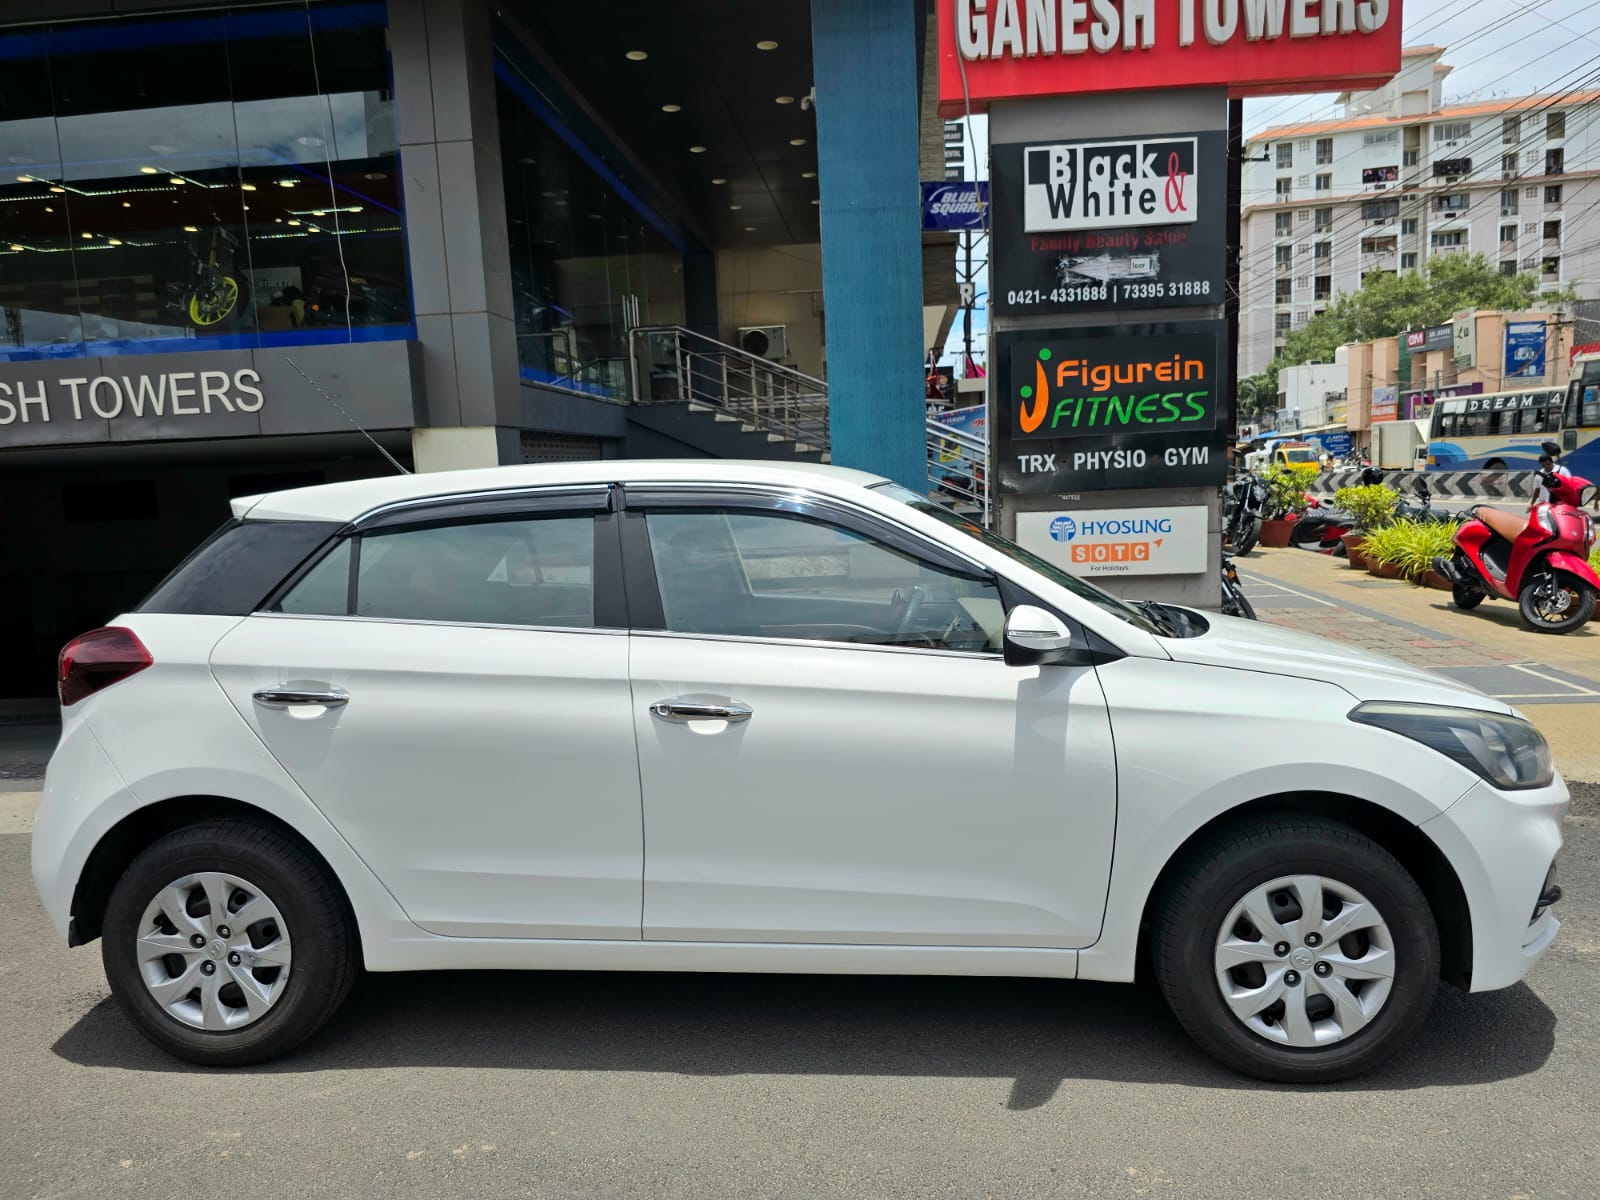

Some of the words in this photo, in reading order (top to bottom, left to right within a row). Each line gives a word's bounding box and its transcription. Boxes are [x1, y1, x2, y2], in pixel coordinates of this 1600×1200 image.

[957, 0, 1155, 60] GANESH
[1179, 0, 1389, 47] TOWERS
[1050, 145, 1158, 185] Black
[941, 191, 977, 203] BLUE
[1046, 180, 1157, 220] White
[1164, 152, 1188, 214] &
[1030, 235, 1081, 253] Family
[1085, 232, 1140, 250] Beauty
[1123, 283, 1165, 300] 73395
[1168, 281, 1210, 297] 31888
[1056, 354, 1204, 391] Figurein
[0, 380, 51, 425] SH
[59, 368, 265, 420] TOWERS
[1051, 391, 1209, 428] FITNESS
[1470, 395, 1534, 410] DREAM
[1017, 454, 1056, 473] TRX
[1073, 449, 1146, 471] PHYSIO
[1164, 446, 1209, 466] GYM
[1081, 518, 1172, 535] HYOSUNG
[1075, 543, 1146, 561] SOTC
